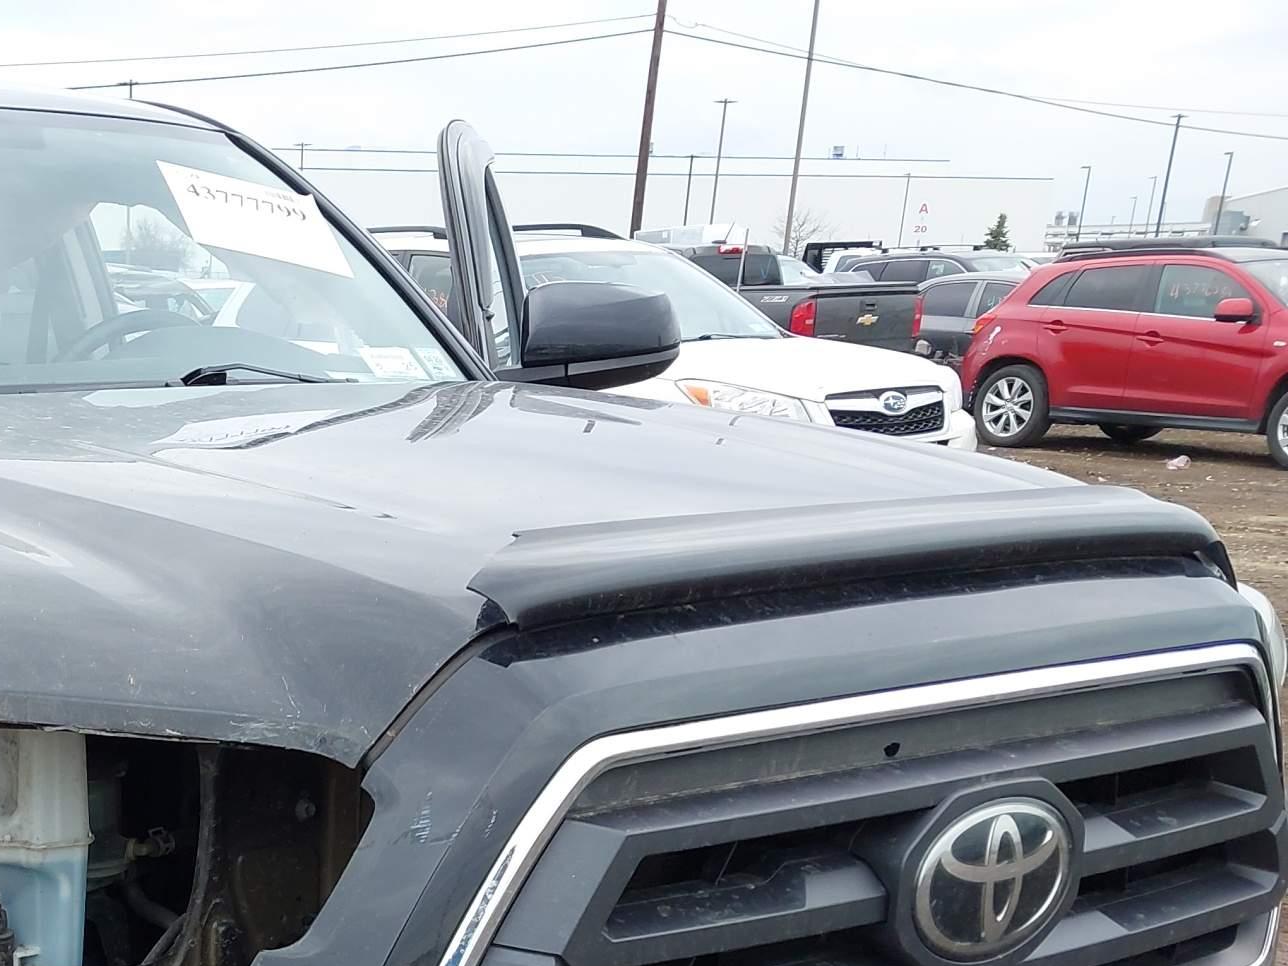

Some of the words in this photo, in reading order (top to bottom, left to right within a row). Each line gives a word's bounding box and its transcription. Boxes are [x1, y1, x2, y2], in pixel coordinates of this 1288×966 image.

[186, 183, 307, 221] 43777799
[918, 203, 929, 214] A
[913, 225, 928, 233] 20
